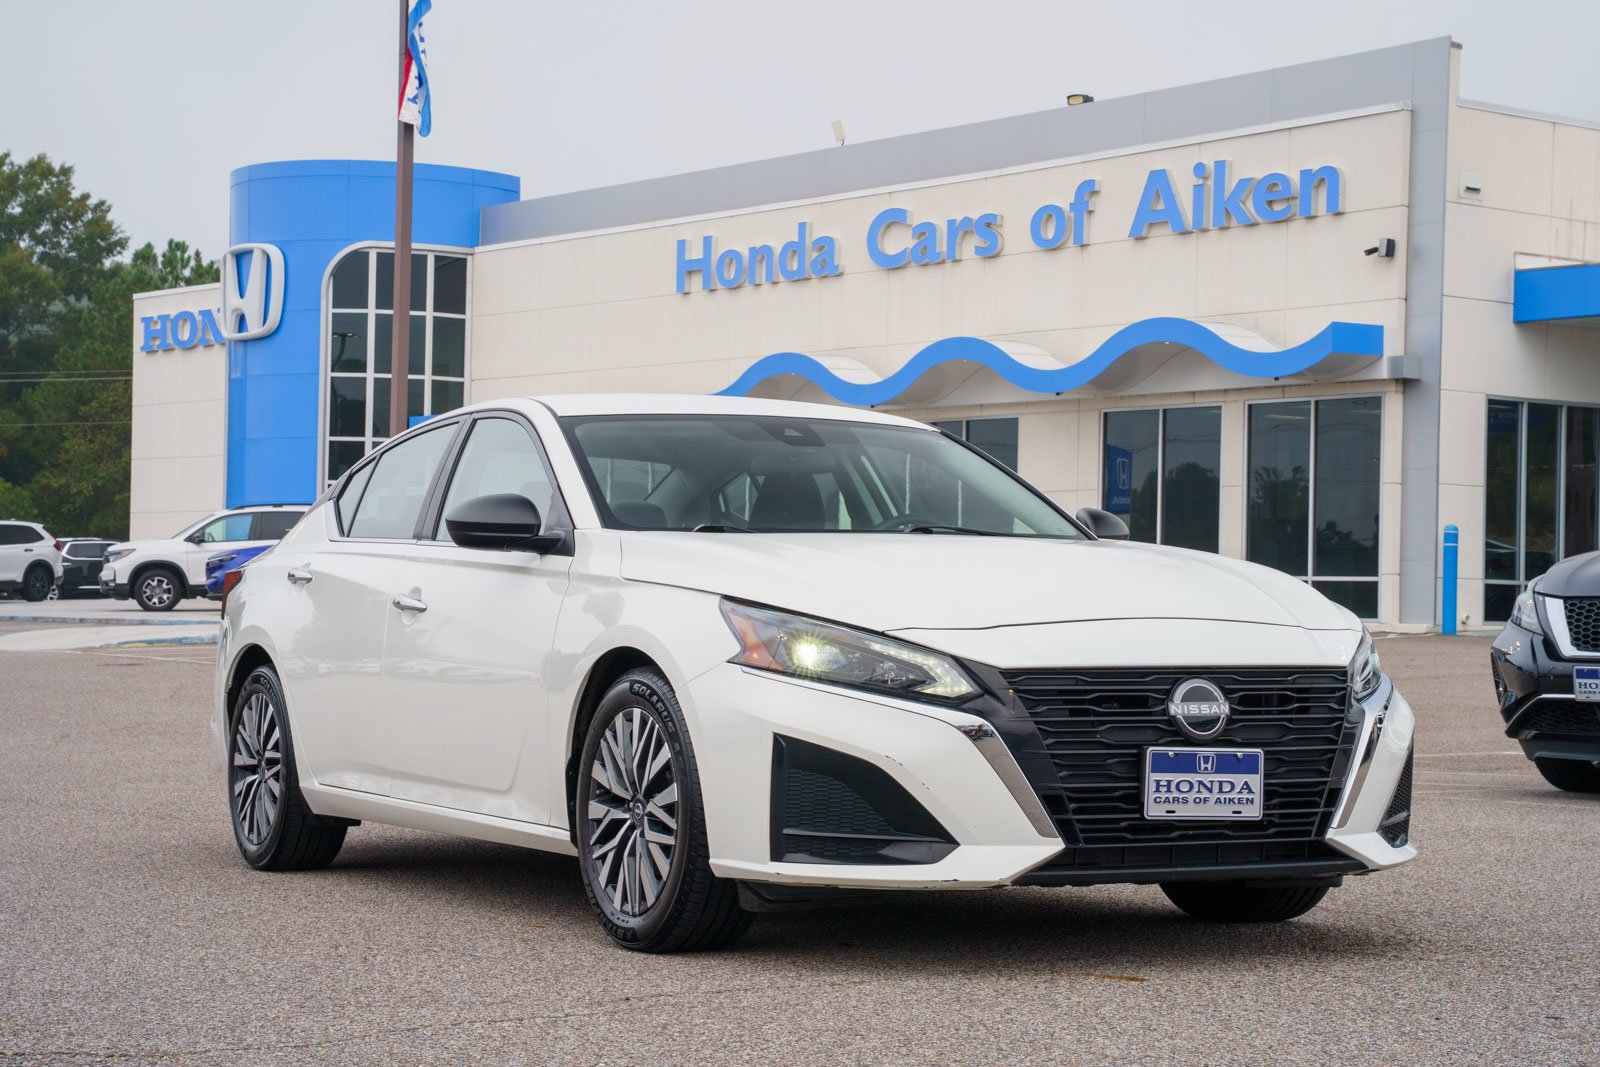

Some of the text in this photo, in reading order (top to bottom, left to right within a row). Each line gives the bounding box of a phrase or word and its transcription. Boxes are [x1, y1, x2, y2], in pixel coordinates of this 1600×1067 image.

[677, 159, 1343, 293] Honda Cars of Aiken
[1578, 682, 1600, 690] HO
[631, 683, 675, 733] SOLARUS
[1171, 704, 1229, 714] NISSAN
[1153, 779, 1255, 793] HONDA
[1153, 796, 1255, 805] CARS OF AIKEN
